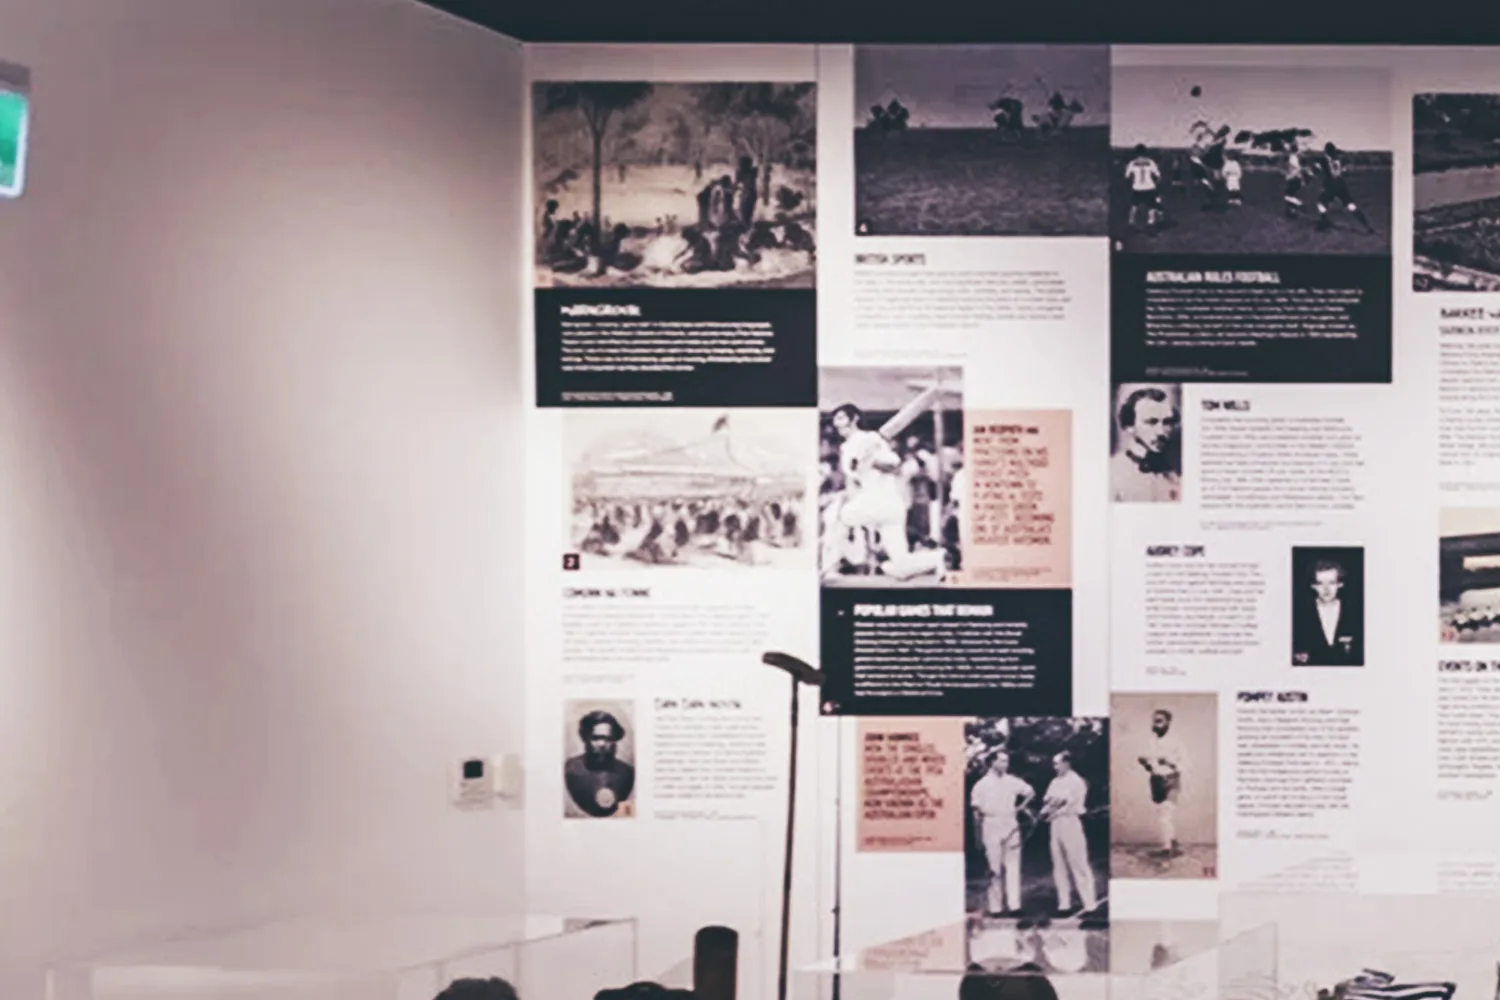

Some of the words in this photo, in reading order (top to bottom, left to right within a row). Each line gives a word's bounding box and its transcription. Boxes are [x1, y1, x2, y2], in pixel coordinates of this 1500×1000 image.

[1146, 270, 1203, 284] AUSTRALIAN
[1204, 270, 1233, 284] RULES
[1234, 270, 1281, 284] FOOTBALL
[1201, 399, 1220, 411] TOM
[1223, 399, 1250, 411] WILLS
[1146, 545, 1180, 557] AUDREY
[1183, 545, 1205, 557] COPE
[1438, 660, 1471, 673] EVENTS
[1475, 660, 1488, 673] ON
[1236, 691, 1273, 703] POMPEY
[1276, 691, 1309, 703] AUSTIN
